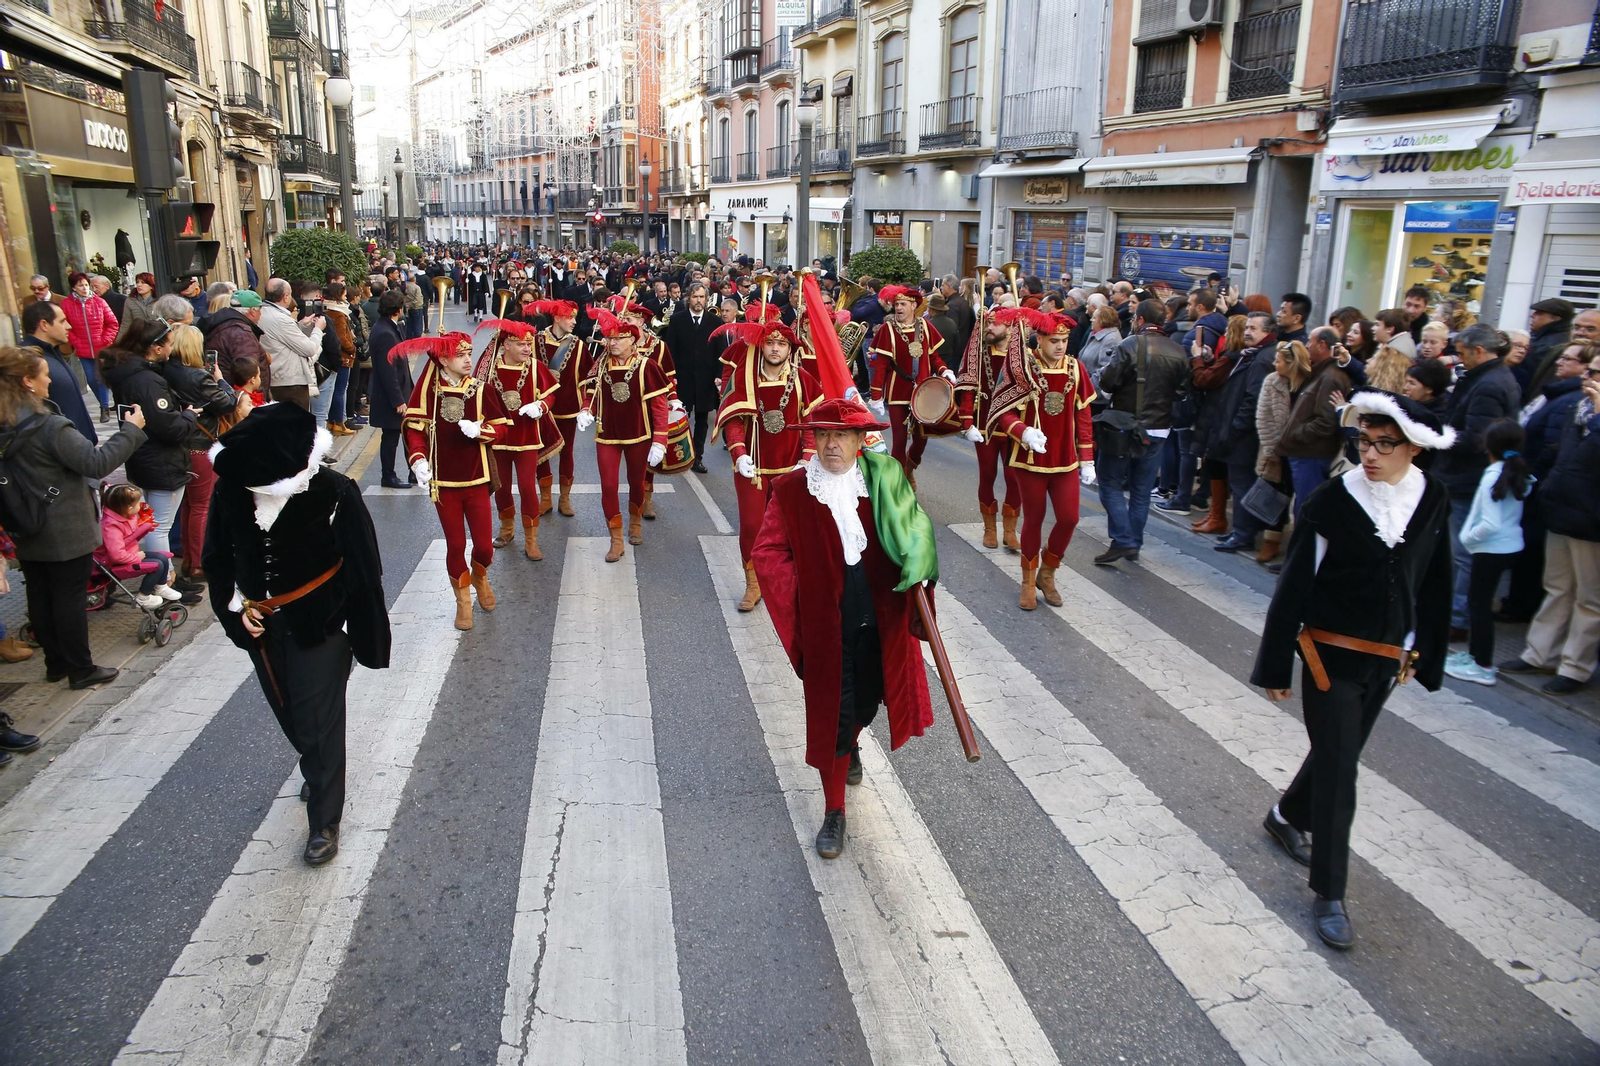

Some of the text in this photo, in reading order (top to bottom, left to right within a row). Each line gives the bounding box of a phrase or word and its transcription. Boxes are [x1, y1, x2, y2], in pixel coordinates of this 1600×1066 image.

[1393, 133, 1450, 147] starshoes
[1428, 173, 1513, 186] Specialists in Comfor
[727, 197, 768, 209] ZARA HOME
